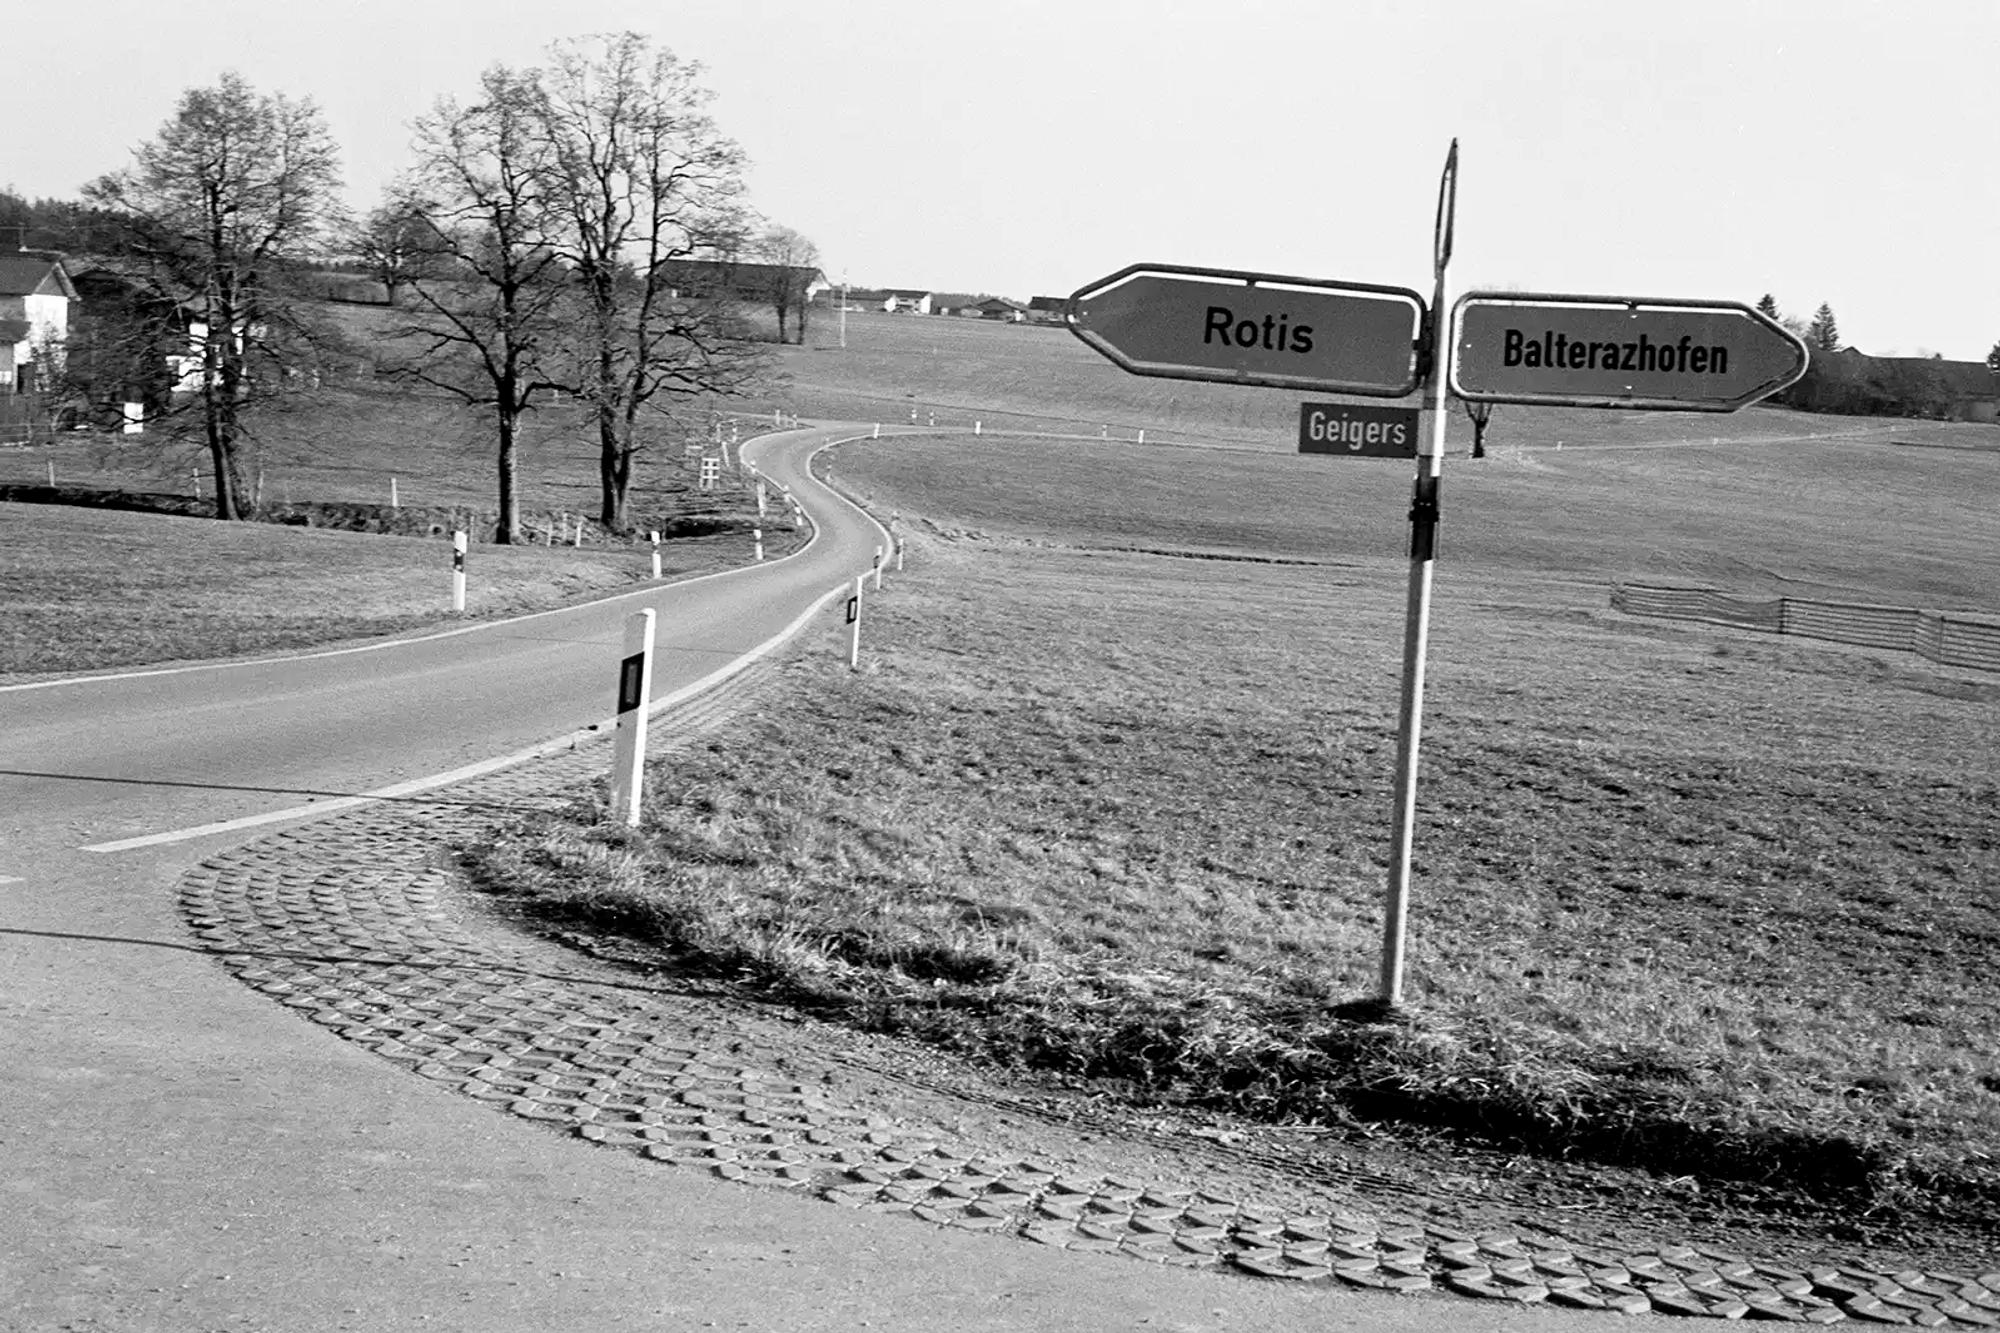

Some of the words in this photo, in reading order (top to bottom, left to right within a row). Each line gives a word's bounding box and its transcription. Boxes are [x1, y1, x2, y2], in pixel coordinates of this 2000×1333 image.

[1204, 306, 1313, 353] Rotis
[1504, 329, 1727, 374] Balterazhofen
[1310, 411, 1406, 450] Geigers
